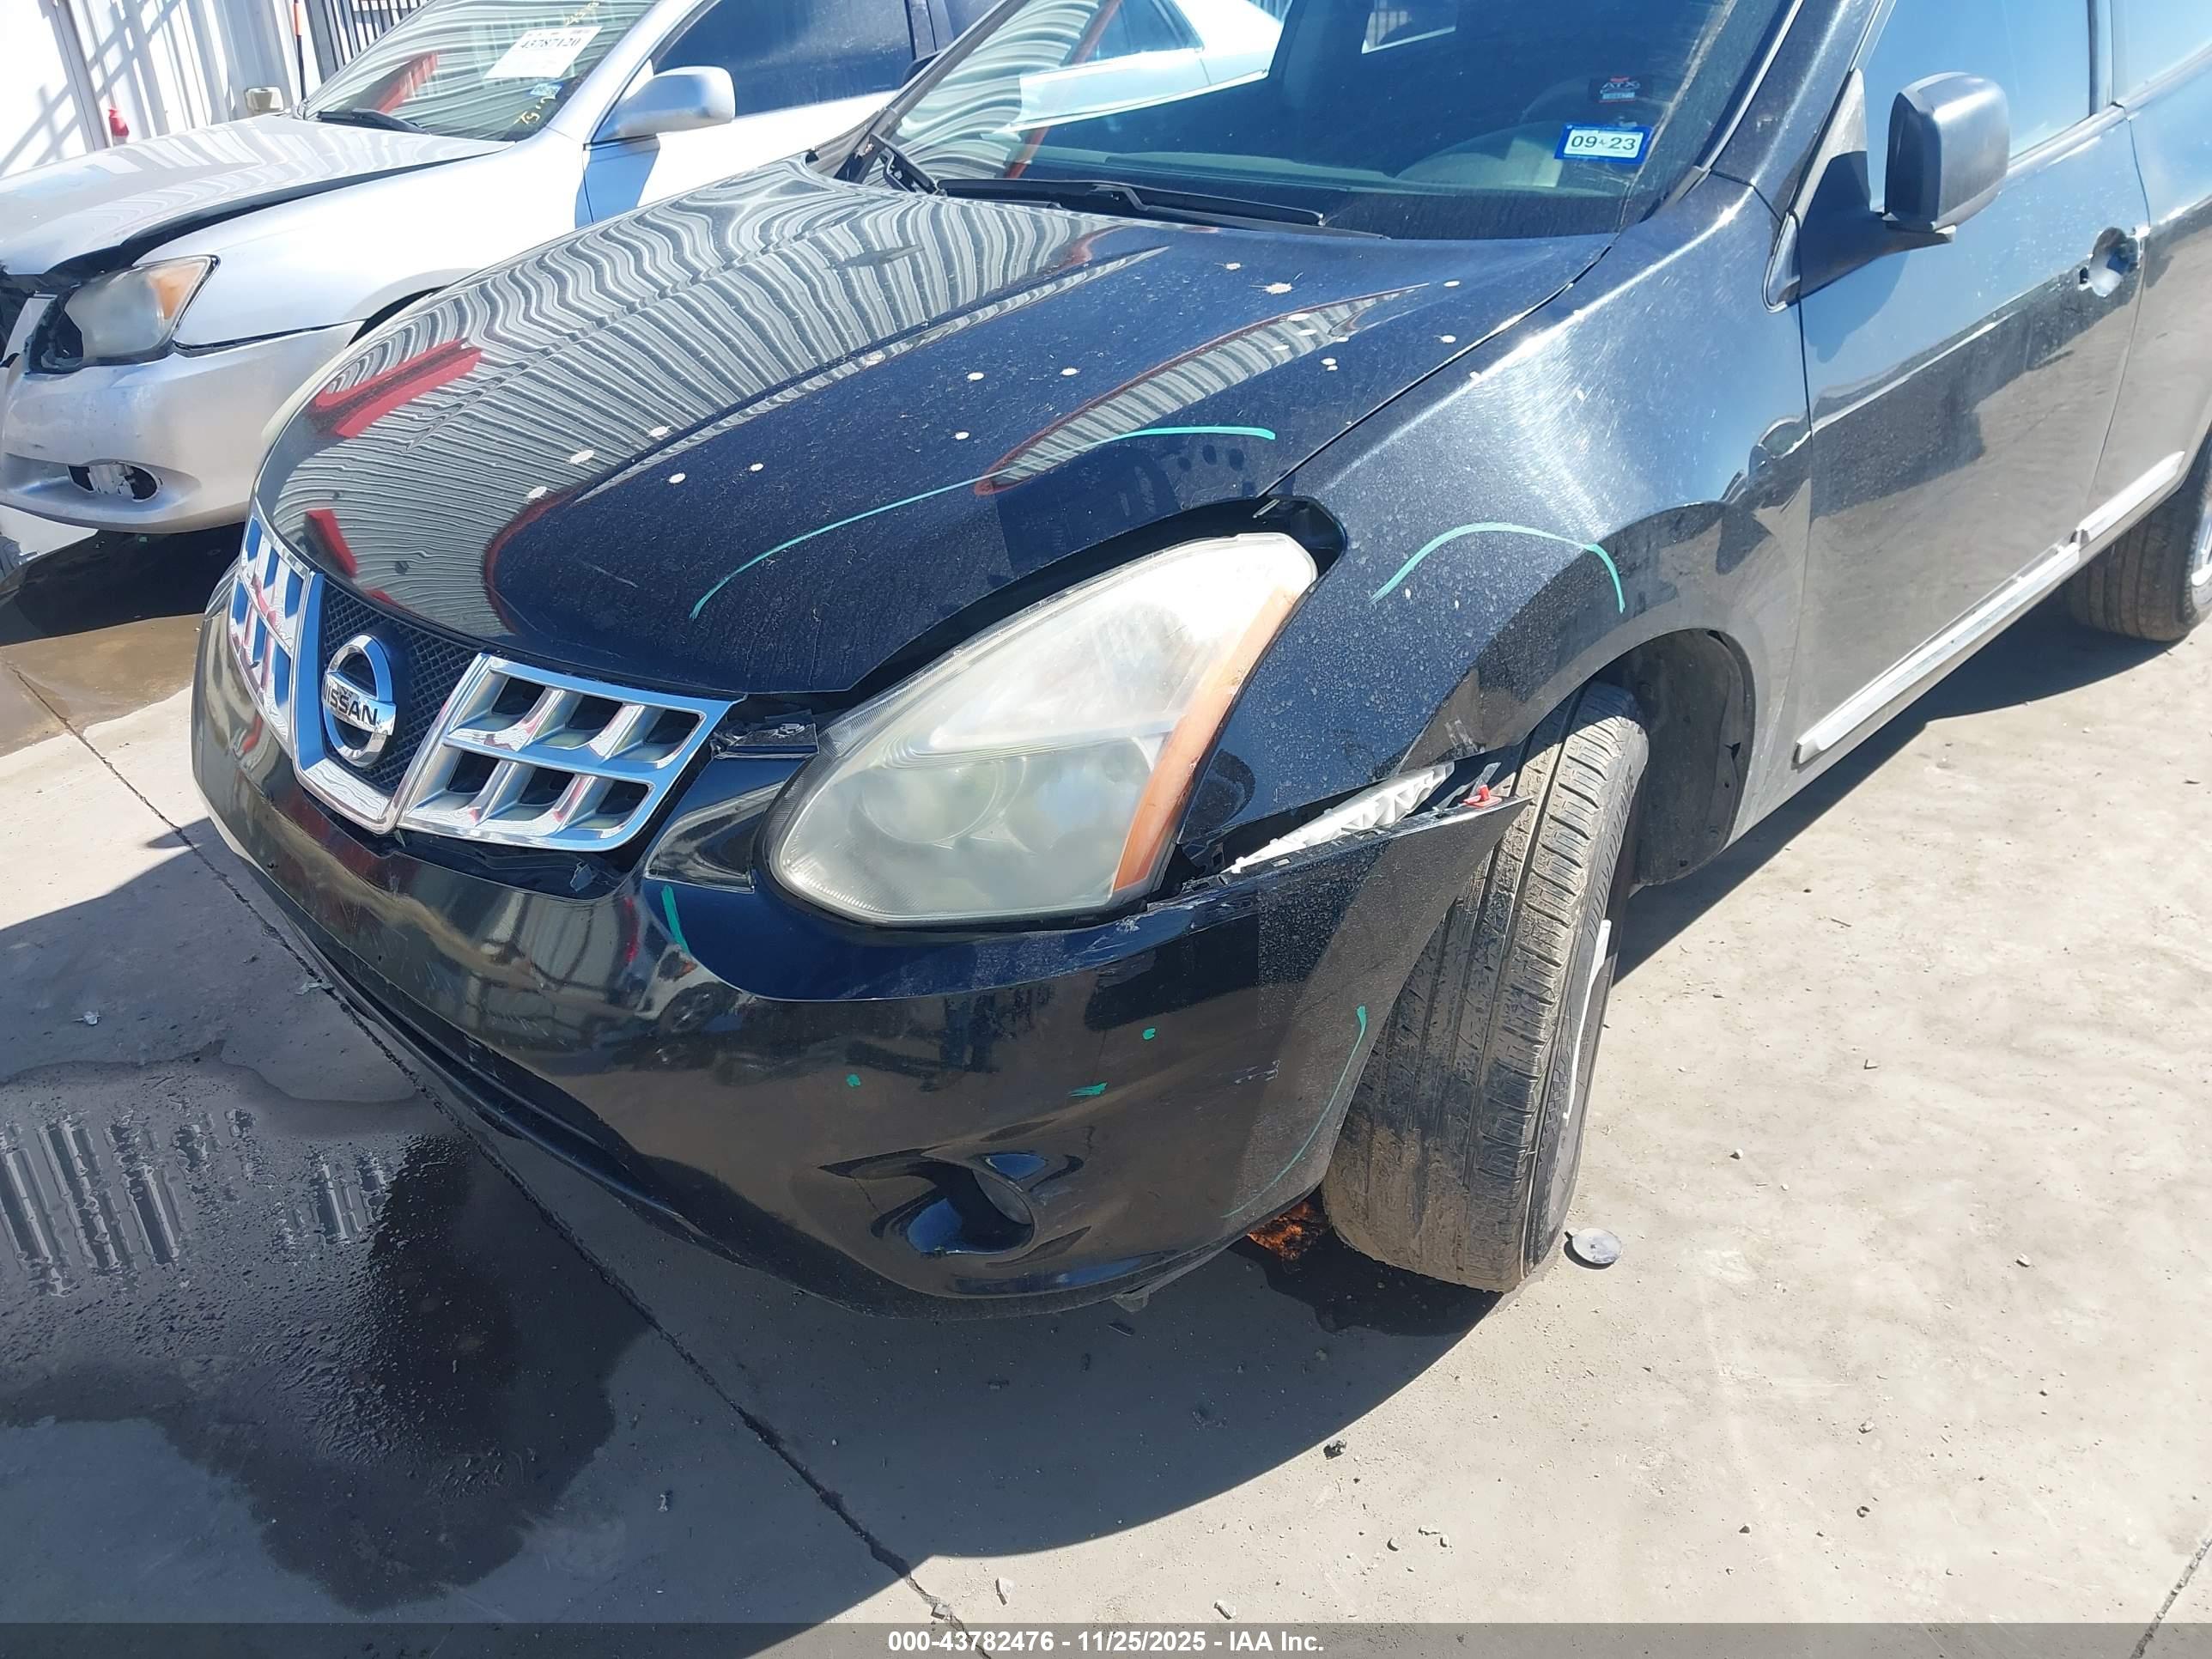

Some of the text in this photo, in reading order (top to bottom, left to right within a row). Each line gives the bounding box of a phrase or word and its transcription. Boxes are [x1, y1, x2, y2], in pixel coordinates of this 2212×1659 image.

[1571, 136, 1636, 150] 09 23
[323, 679, 378, 726] NISSAN
